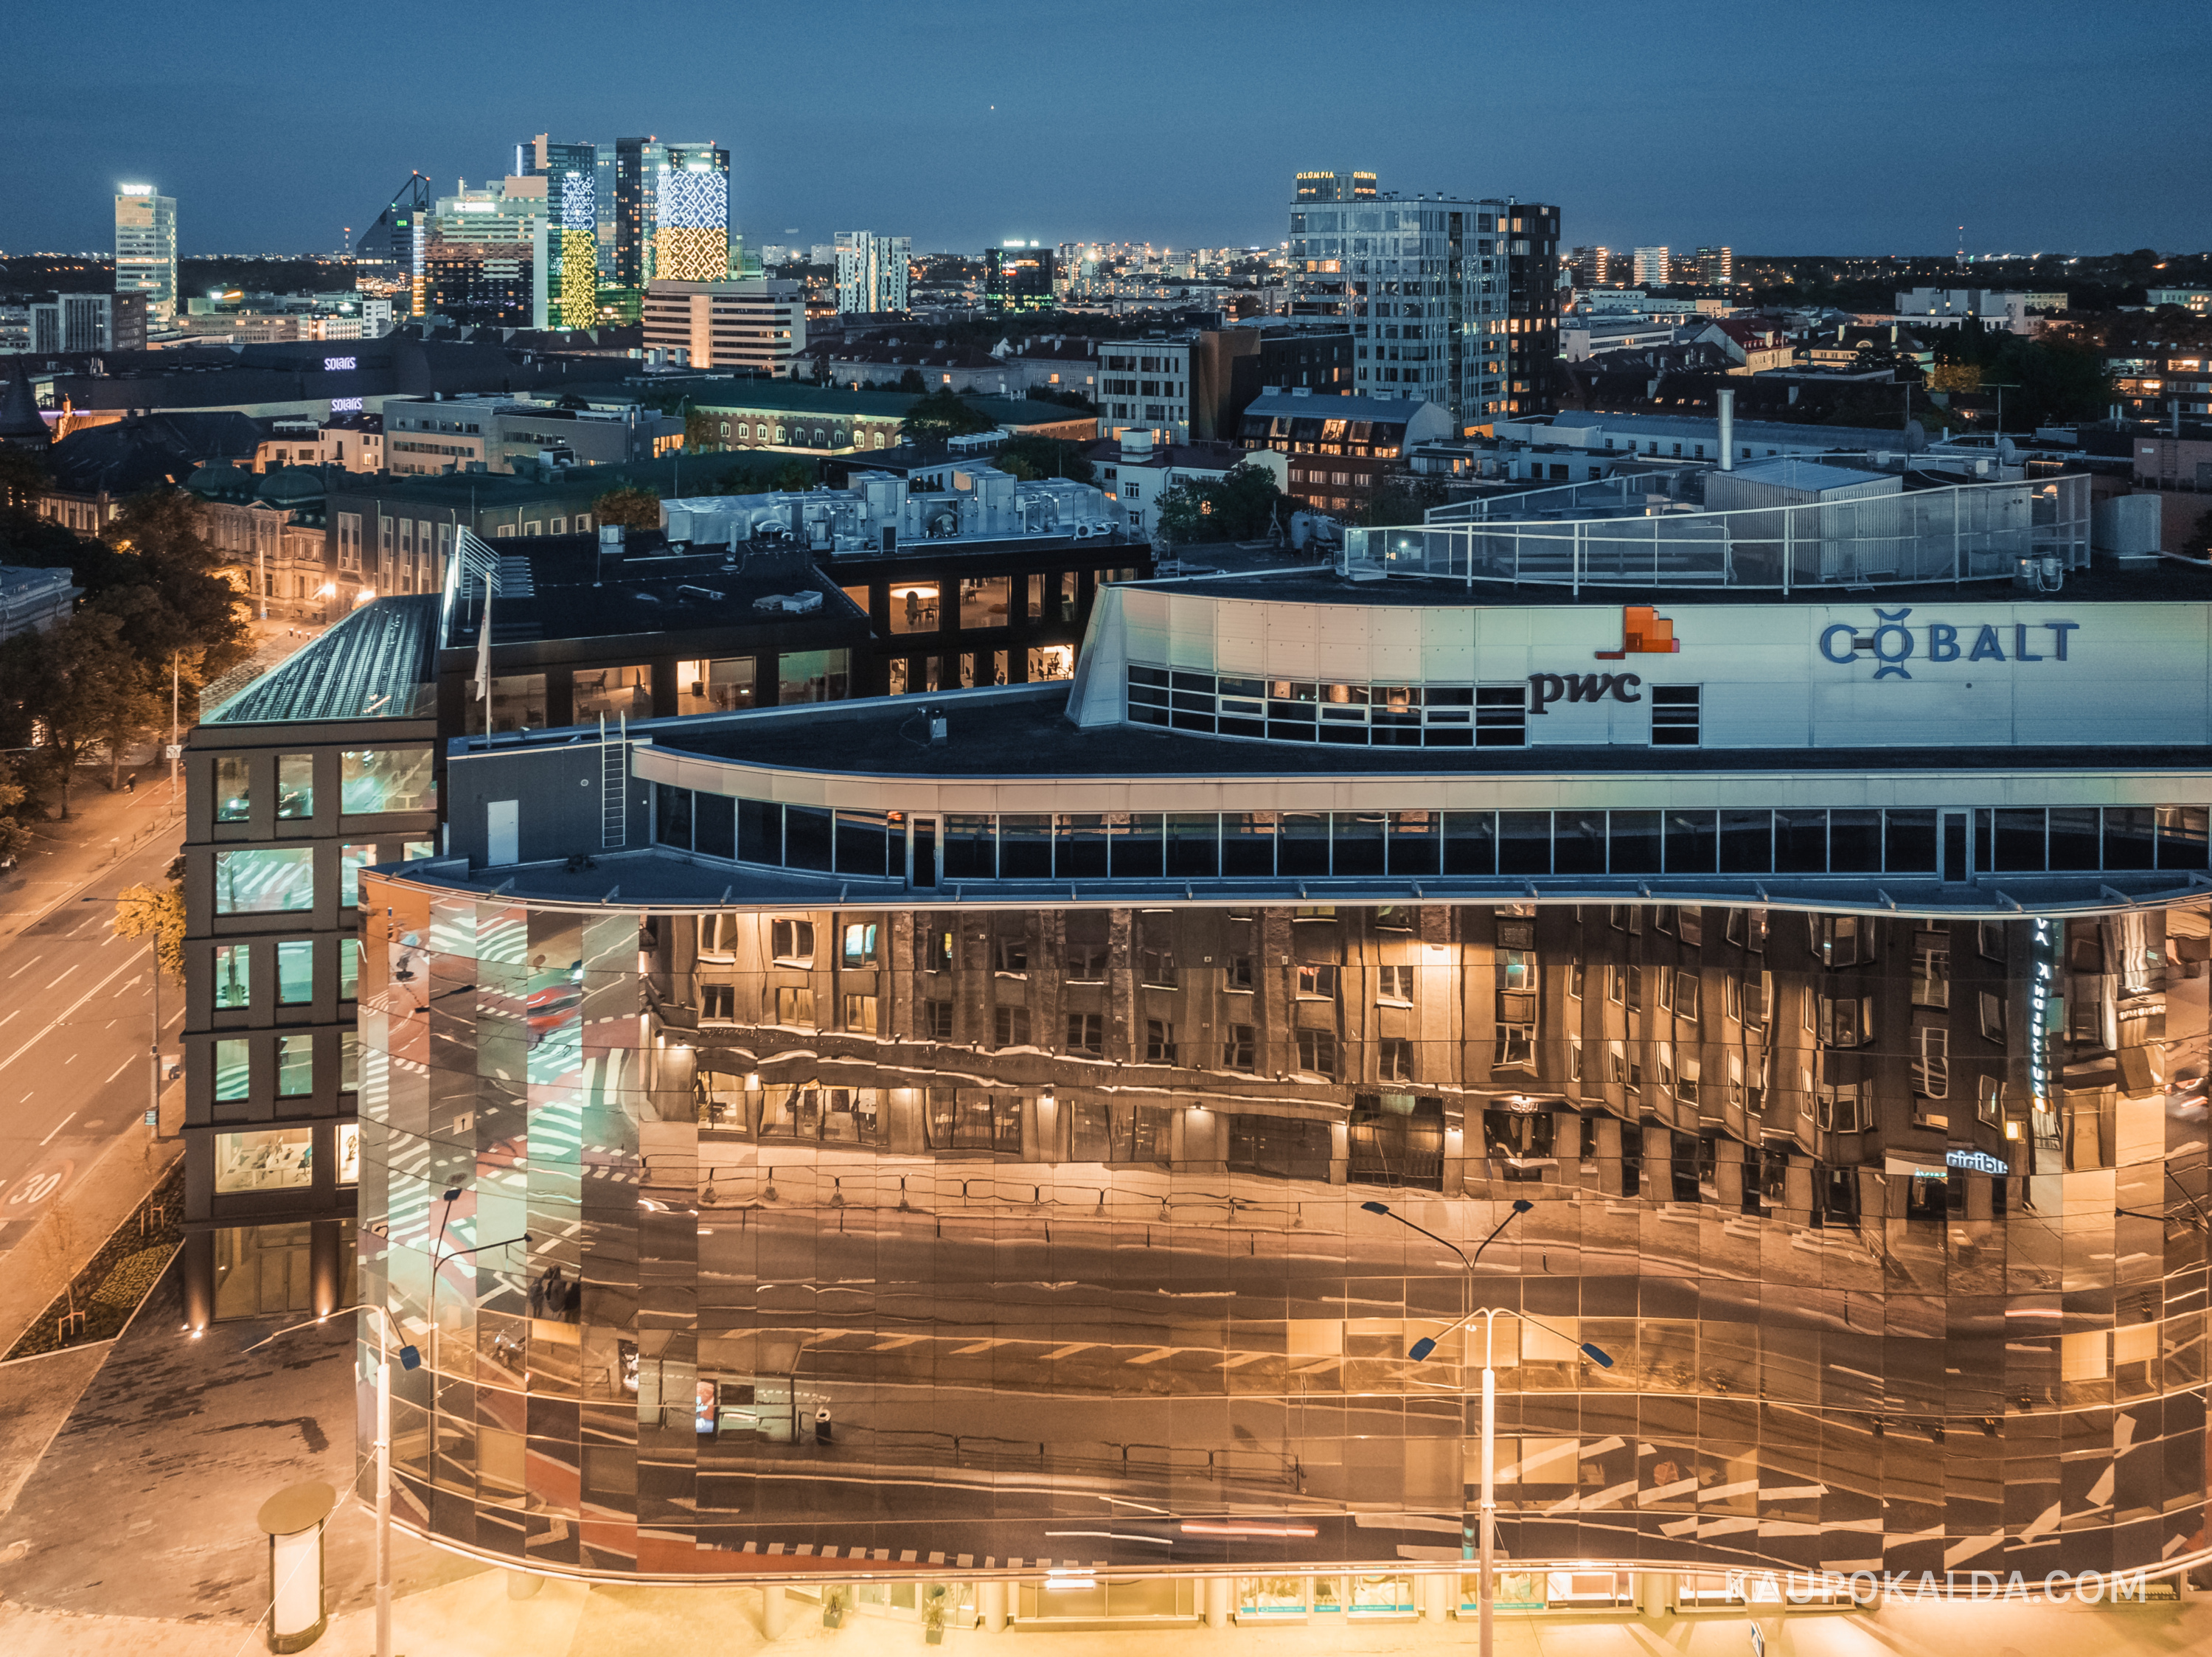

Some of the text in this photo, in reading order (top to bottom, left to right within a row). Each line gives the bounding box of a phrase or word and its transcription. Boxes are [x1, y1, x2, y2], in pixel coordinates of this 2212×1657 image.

[1820, 623, 2080, 664] COBALT
[1528, 673, 1641, 715] pwc
[10, 1173, 61, 1204] 30
